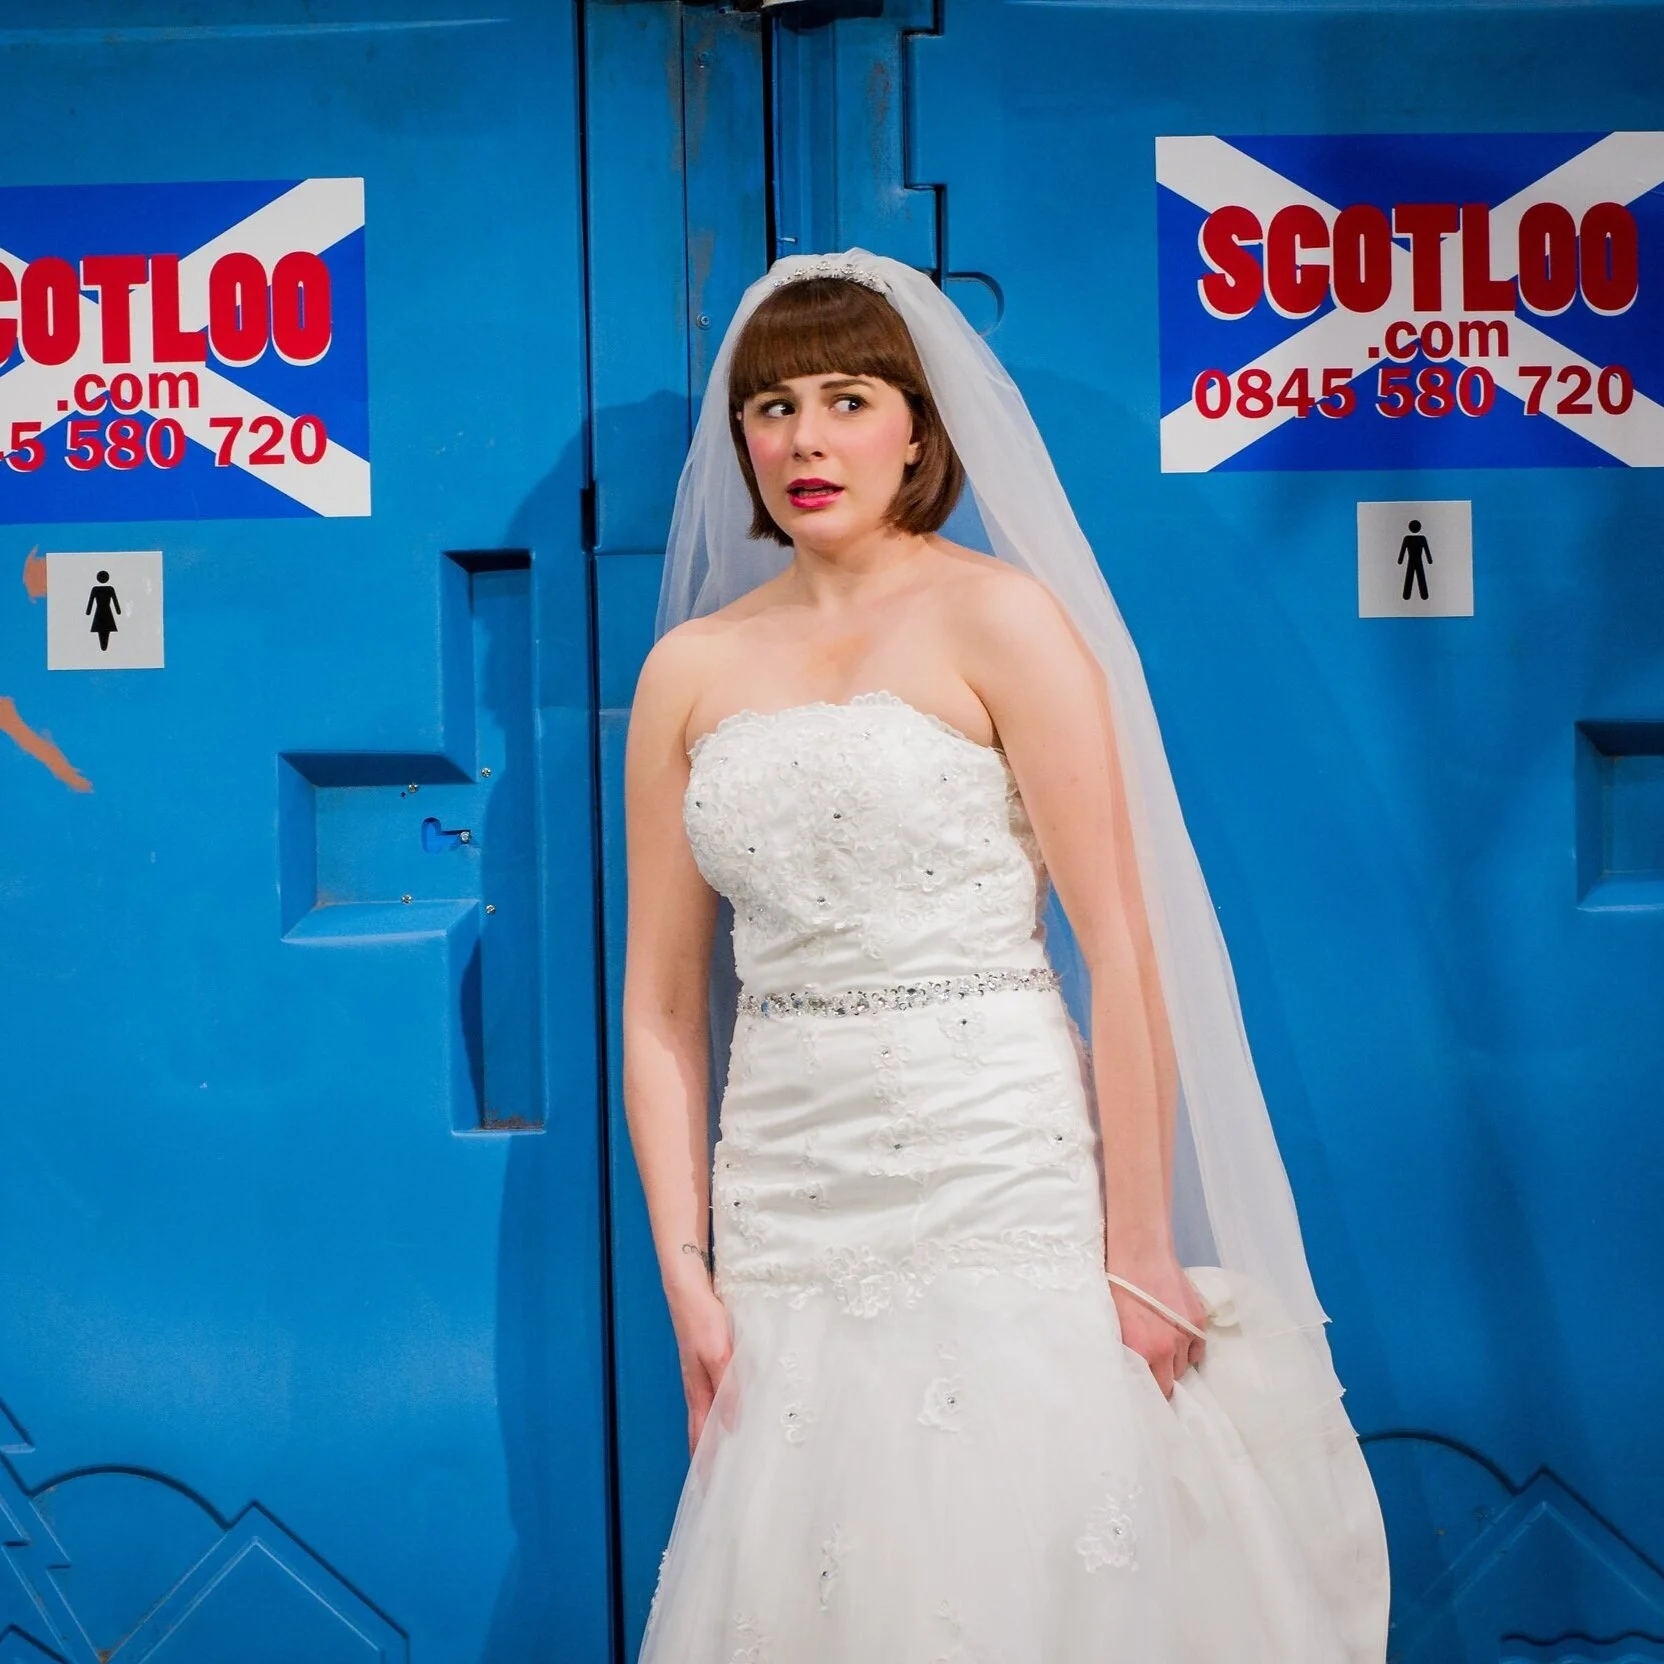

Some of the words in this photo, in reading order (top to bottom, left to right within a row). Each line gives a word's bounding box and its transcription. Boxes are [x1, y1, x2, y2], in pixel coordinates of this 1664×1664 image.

[1198, 202, 1639, 320] SCOTLOO
[0, 251, 332, 367] OTLOO
[1367, 319, 1510, 361] .com
[56, 371, 200, 413] .com
[1194, 366, 1357, 419] 0845
[1376, 366, 1496, 418] 580
[1518, 364, 1635, 416] 720
[0, 420, 46, 472] 5
[64, 416, 187, 471] 580
[208, 414, 328, 468] 720
